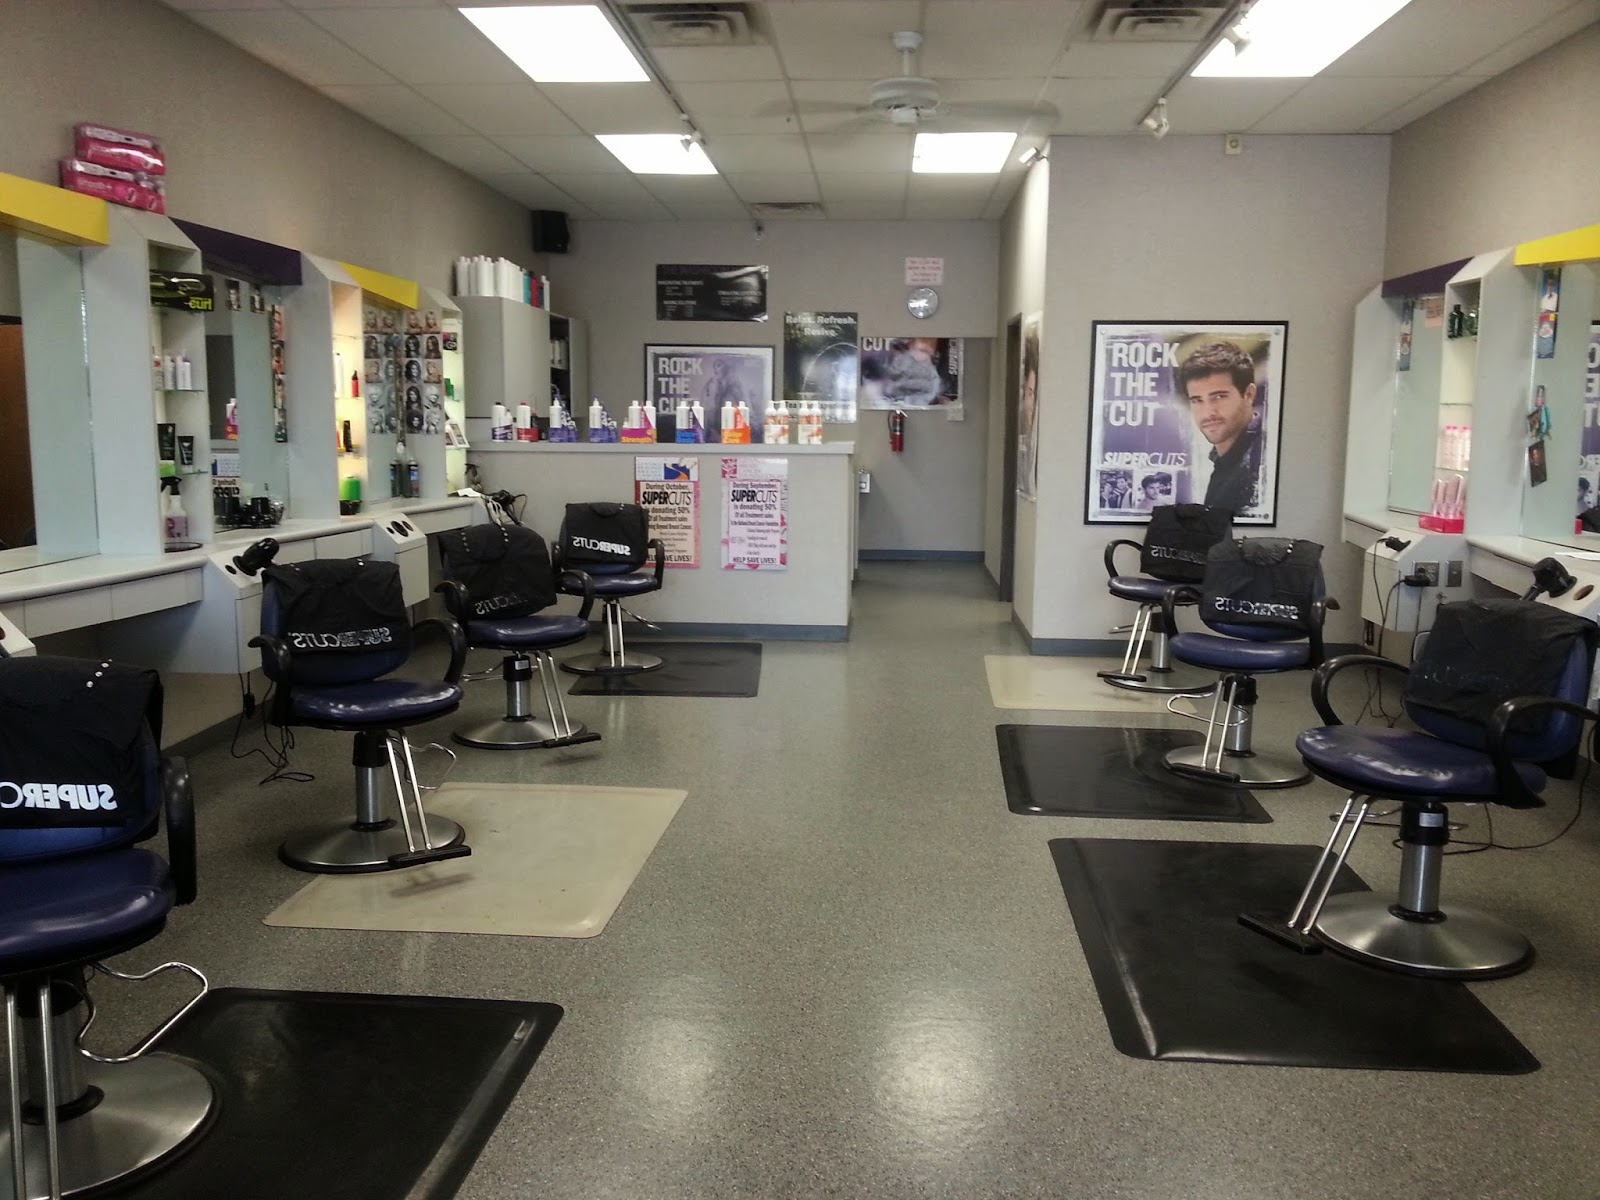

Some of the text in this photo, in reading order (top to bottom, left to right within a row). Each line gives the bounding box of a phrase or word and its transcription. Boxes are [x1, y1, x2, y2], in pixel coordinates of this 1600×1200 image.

[817, 315, 857, 324] Refresh.
[804, 327, 838, 337] Revive.
[862, 337, 893, 351] CUT
[1111, 342, 1180, 368] ROCK
[657, 357, 704, 375] ROCK
[657, 377, 691, 395] THE
[1109, 372, 1160, 397] THE
[1108, 401, 1161, 427] CUT
[1103, 451, 1188, 467] SUPERCUTS
[646, 483, 664, 491] During
[732, 481, 749, 490] During
[641, 490, 692, 506] SUPERCUTS
[731, 489, 777, 503] SUPERCUTS
[651, 506, 676, 515] donating
[678, 506, 690, 514] 50%
[740, 503, 763, 511] donating
[764, 503, 777, 511] 50%
